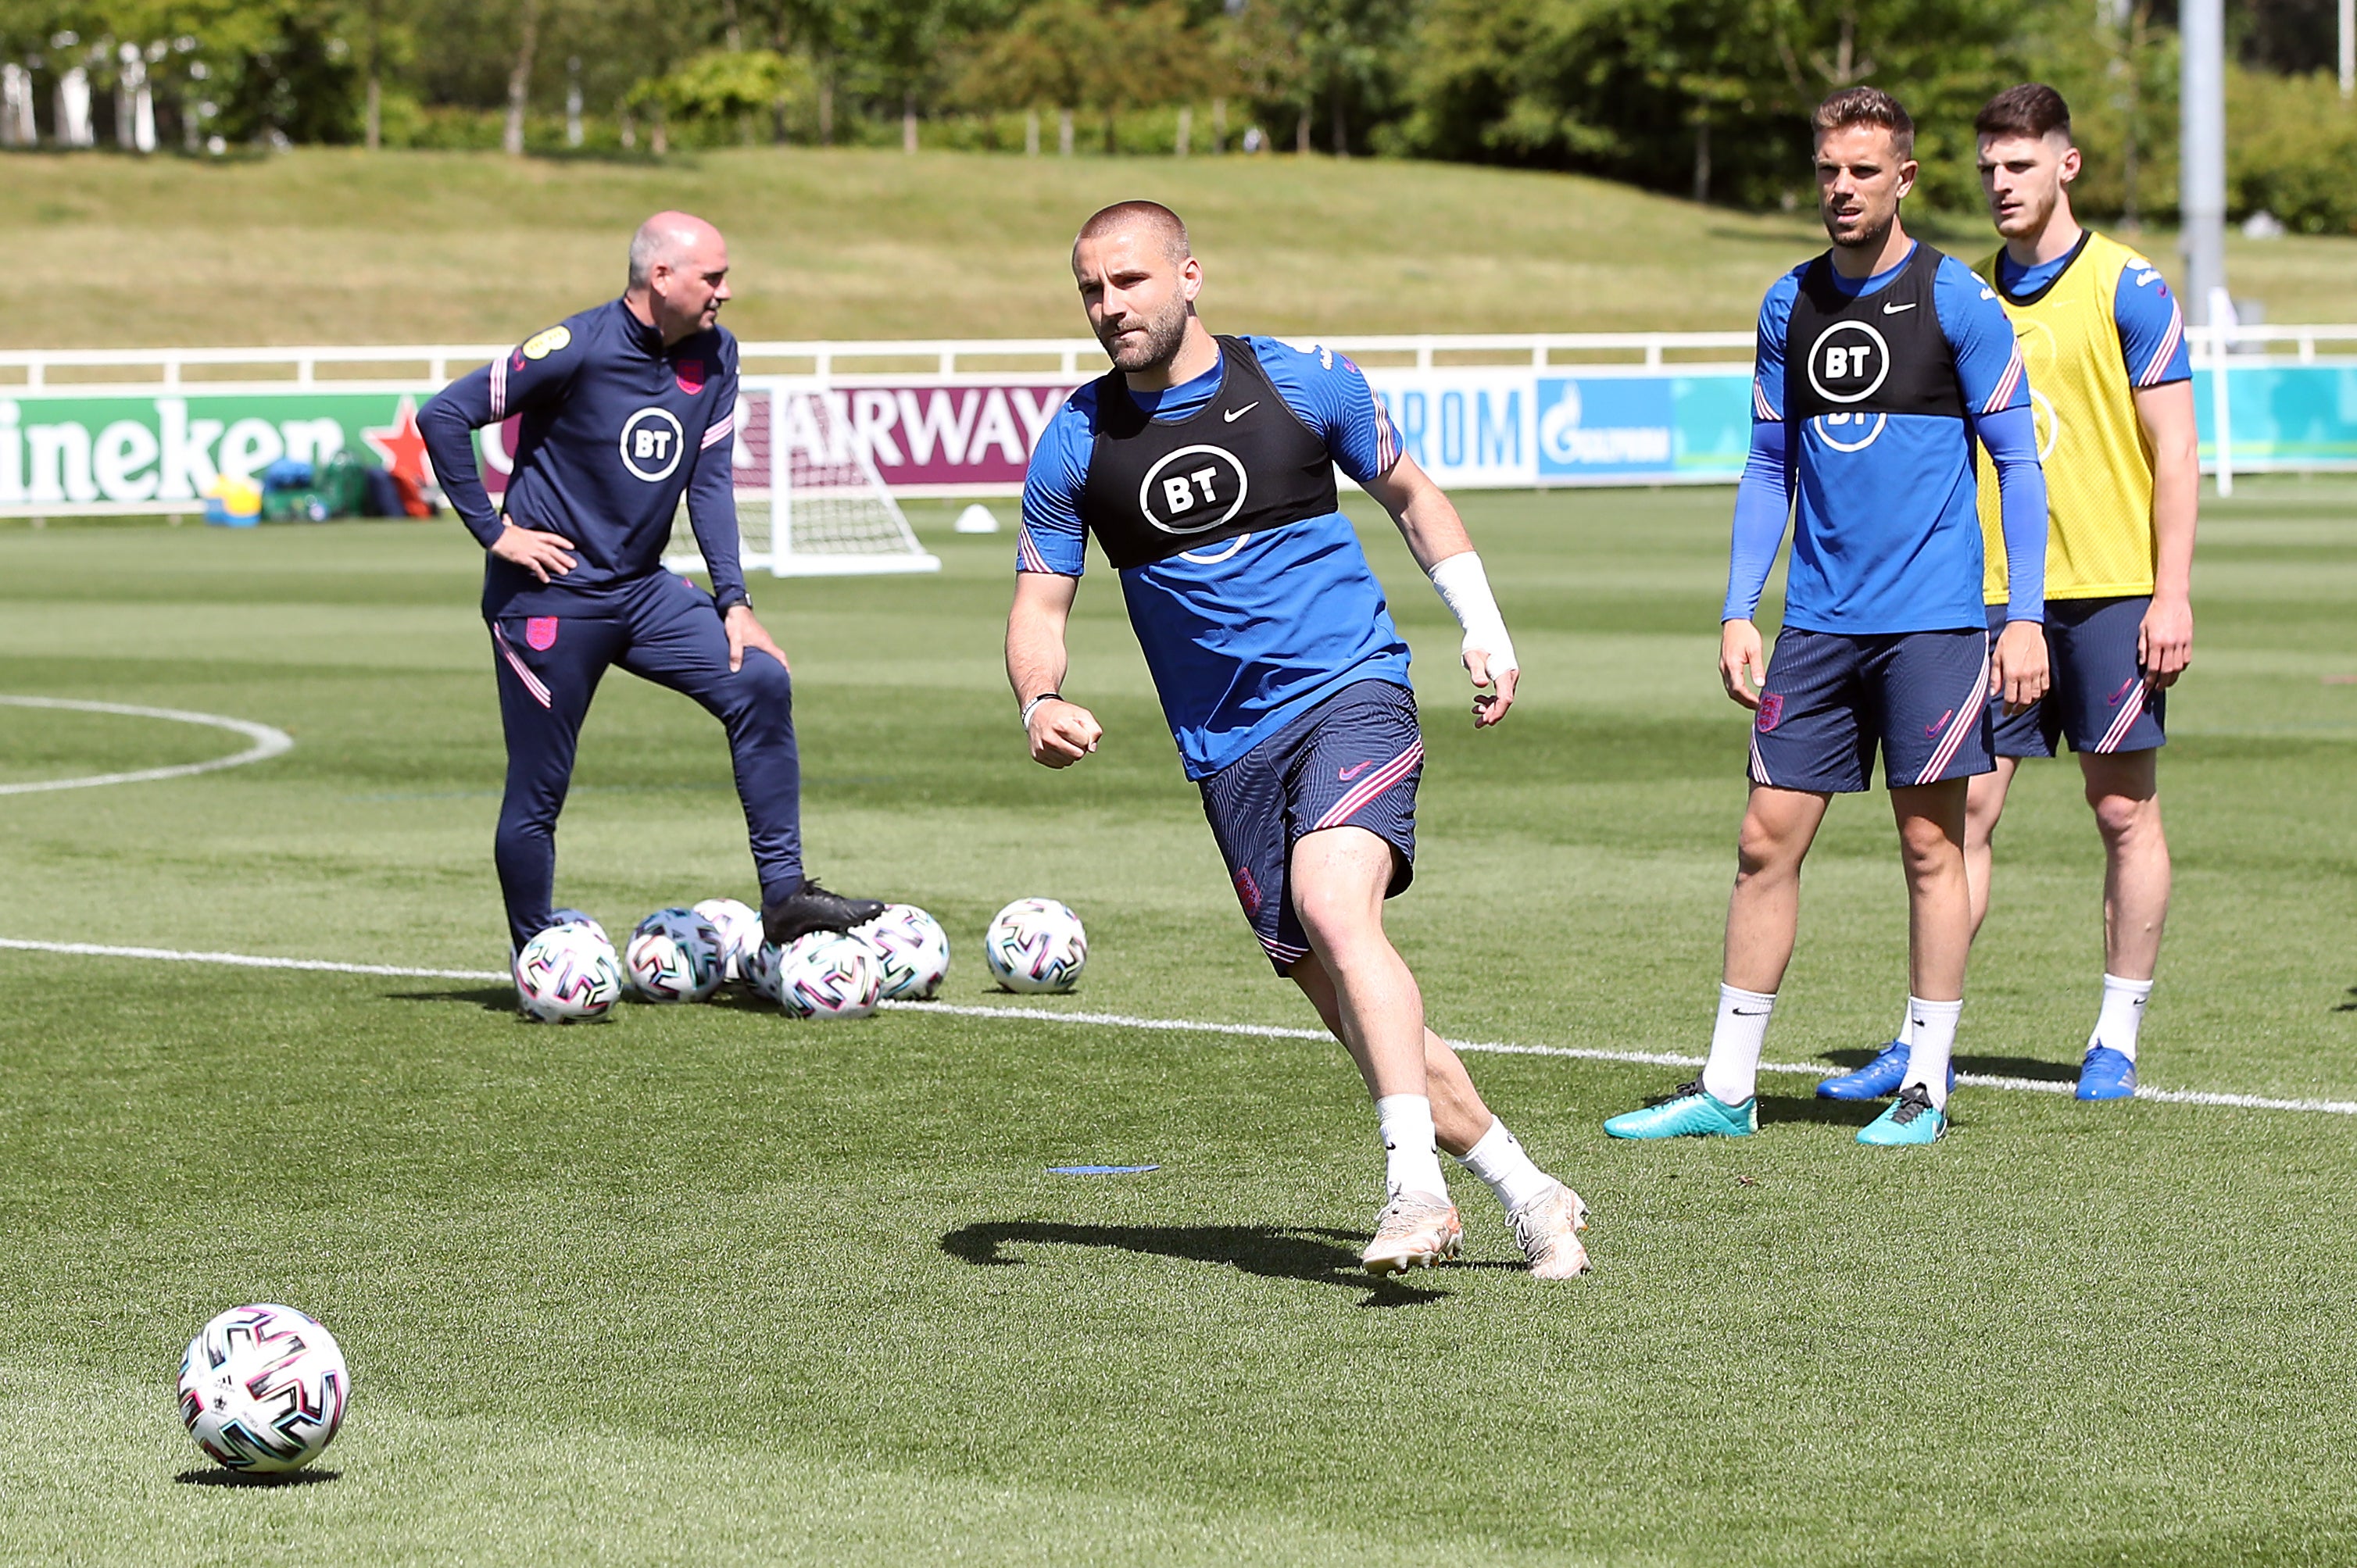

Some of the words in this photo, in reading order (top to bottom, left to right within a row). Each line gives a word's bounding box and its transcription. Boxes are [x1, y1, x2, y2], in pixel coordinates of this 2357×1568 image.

[1826, 346, 1871, 378] BT
[635, 430, 671, 459] BT
[1380, 391, 1519, 466] ROM
[1163, 466, 1217, 513] BT
